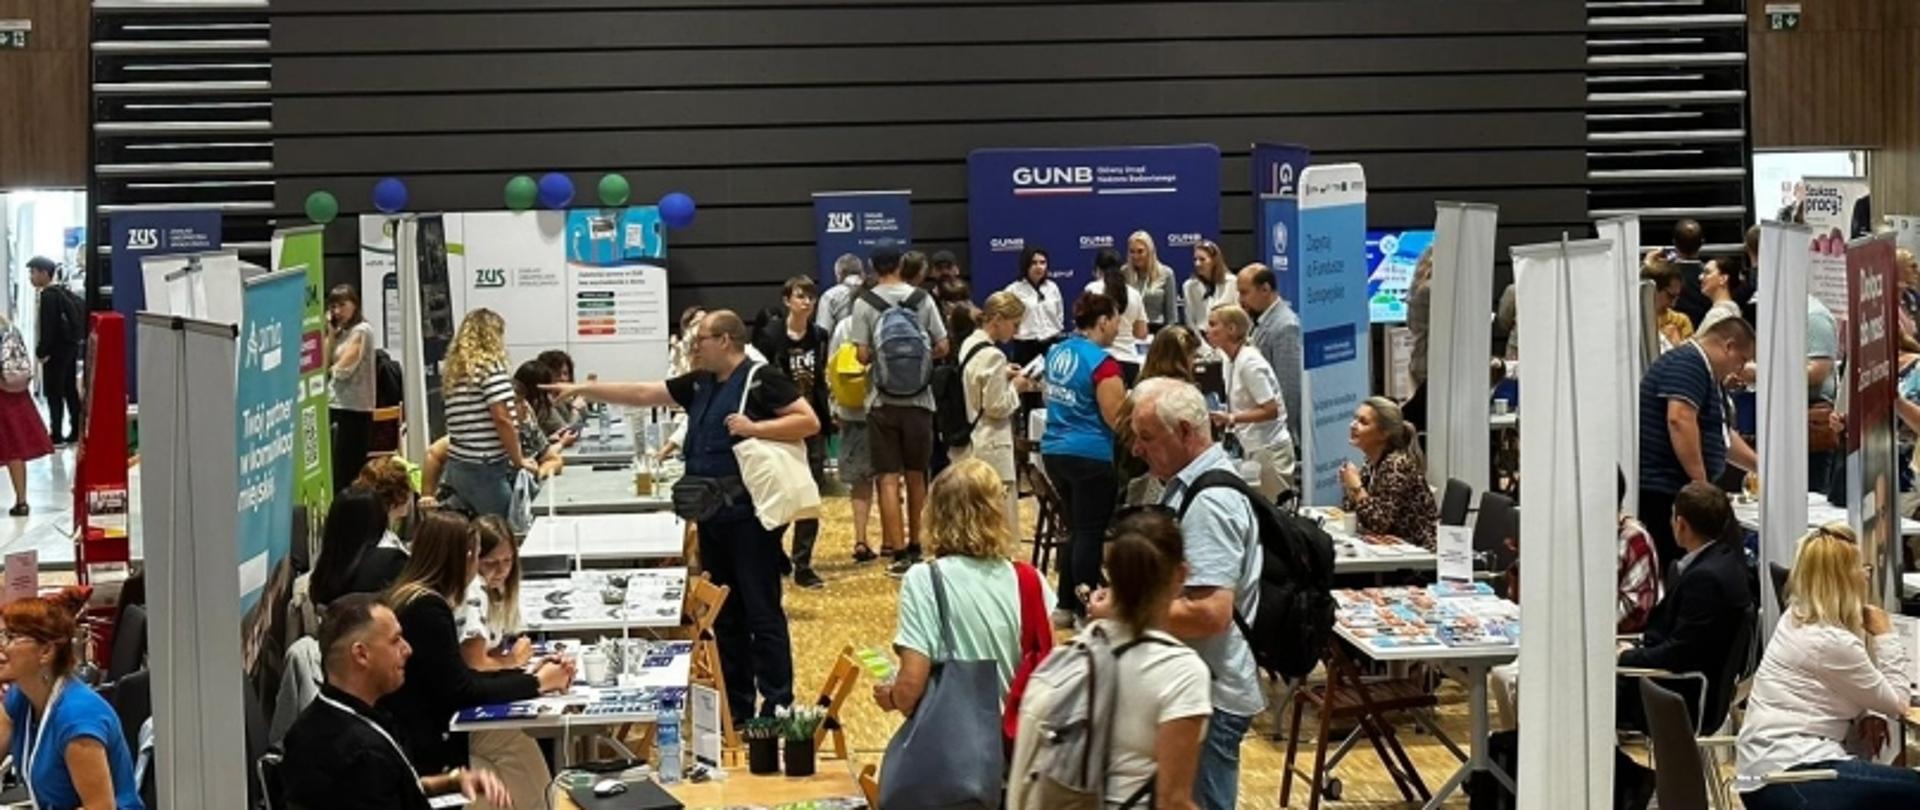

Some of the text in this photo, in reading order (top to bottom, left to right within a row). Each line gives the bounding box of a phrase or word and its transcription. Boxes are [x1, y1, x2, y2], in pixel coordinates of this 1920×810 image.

[1013, 167, 1093, 184] GUNB
[1805, 195, 1843, 216] pracy?
[826, 212, 855, 232] ZUS
[126, 228, 159, 250] ZUS
[990, 238, 1025, 248] GUNB
[1080, 235, 1115, 245] GUNB
[1168, 233, 1203, 243] GUNB
[474, 269, 506, 288] ZUS
[243, 398, 294, 441] Twój partner
